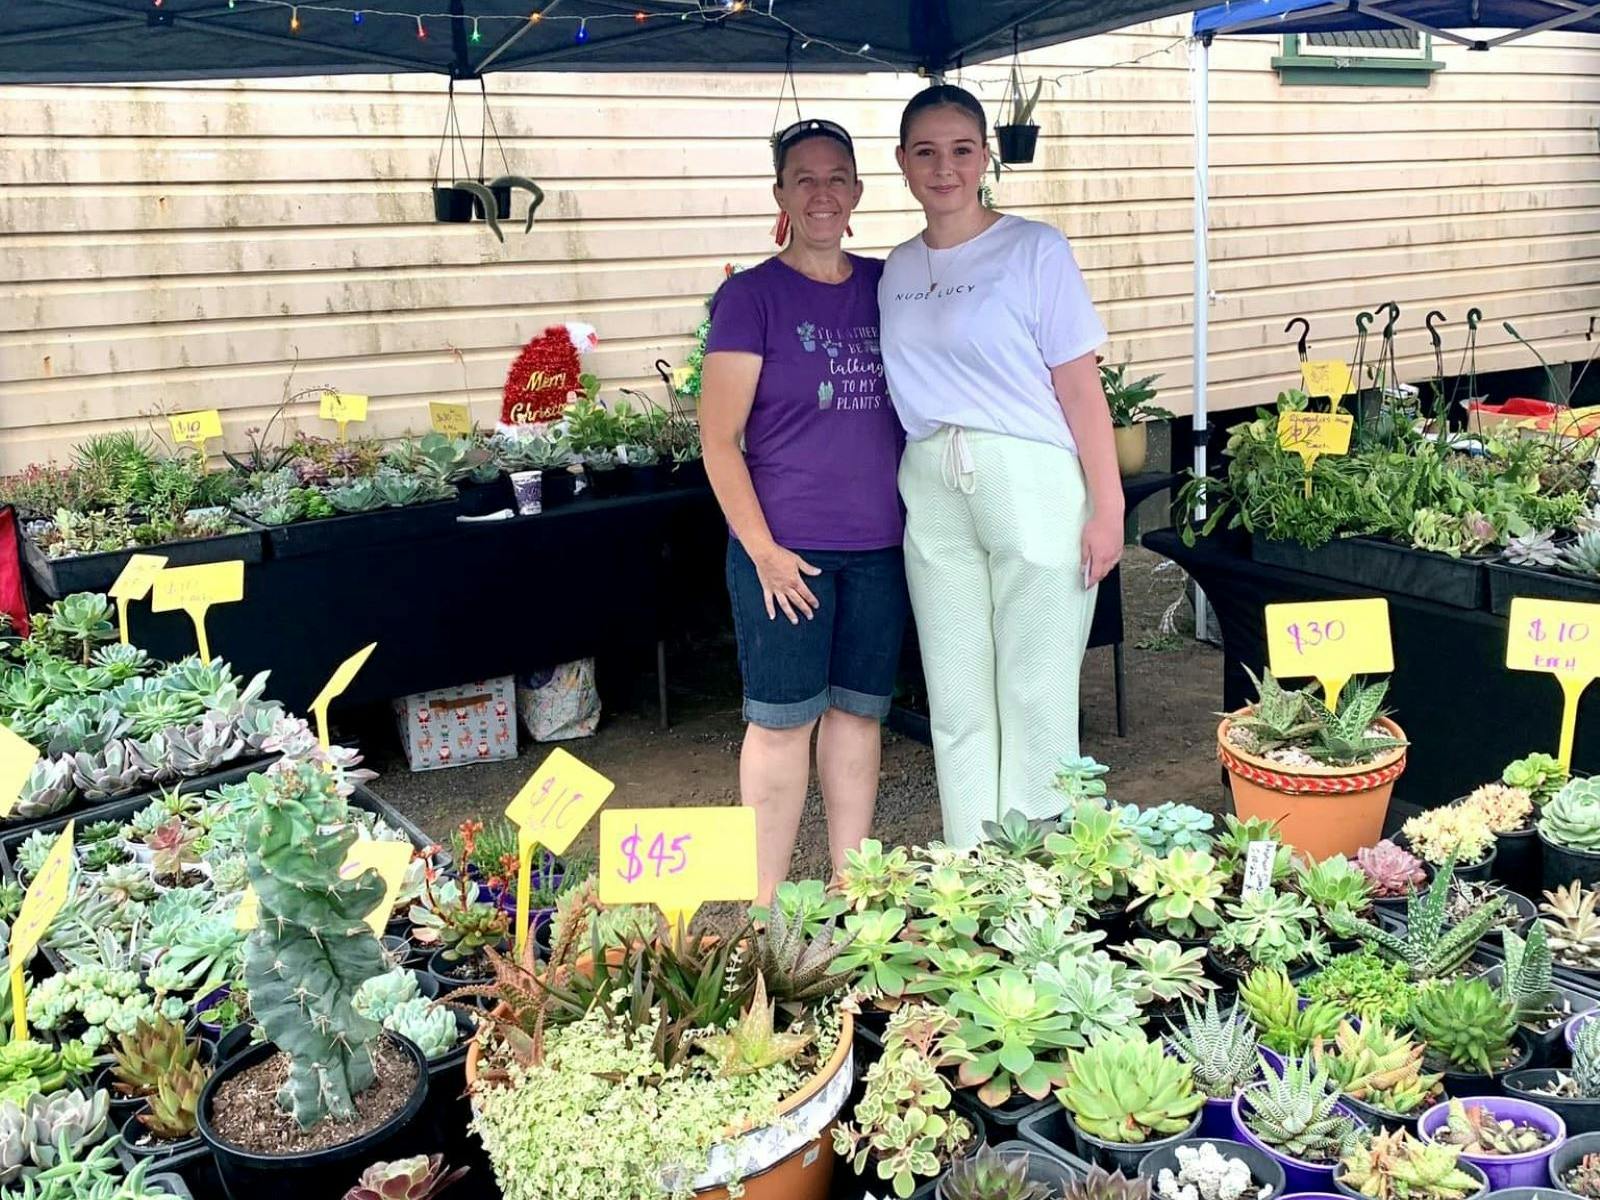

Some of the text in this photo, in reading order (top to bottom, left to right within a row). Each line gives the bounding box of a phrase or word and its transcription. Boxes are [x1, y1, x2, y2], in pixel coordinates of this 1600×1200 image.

[938, 284, 976, 299] LUCY
[848, 343, 863, 354] BE
[830, 358, 884, 377] talking
[523, 371, 567, 391] Merry
[842, 379, 877, 393] TO MY
[836, 396, 881, 410] PLANTS
[1287, 619, 1345, 655] $30
[616, 823, 692, 884] $45
